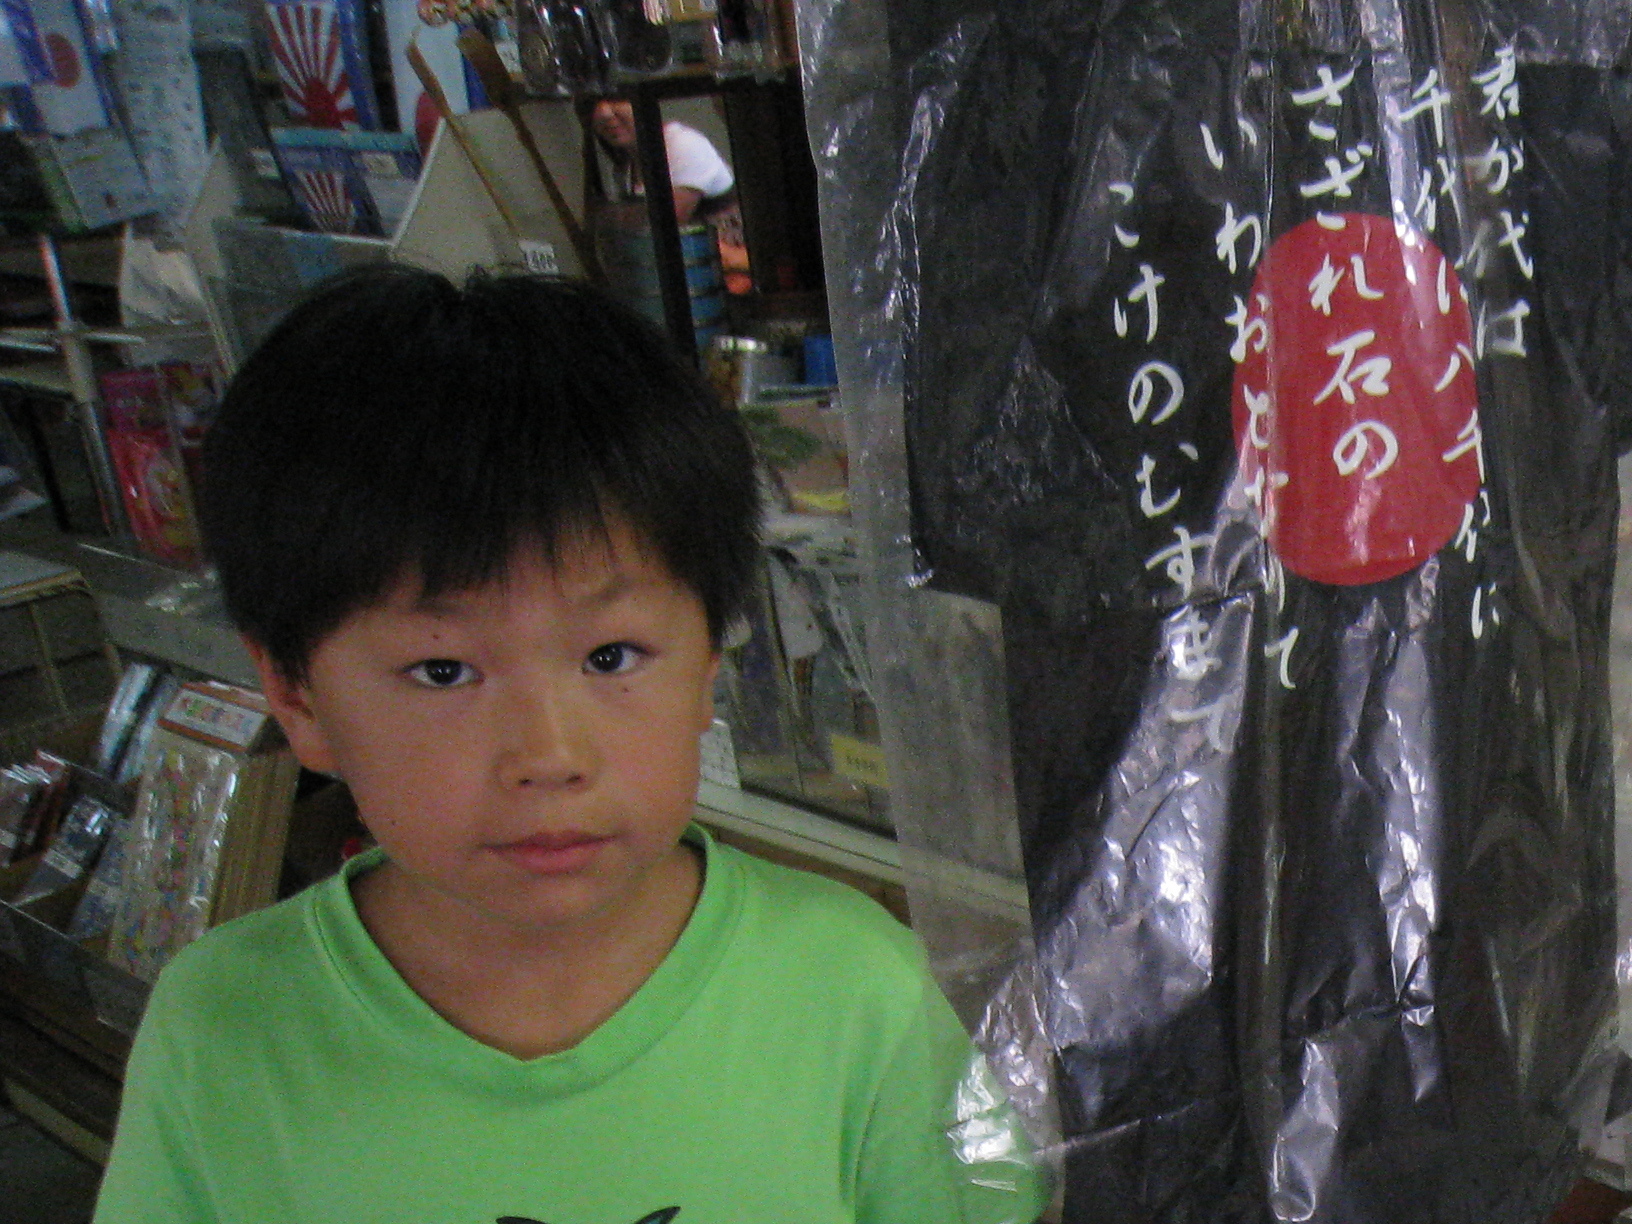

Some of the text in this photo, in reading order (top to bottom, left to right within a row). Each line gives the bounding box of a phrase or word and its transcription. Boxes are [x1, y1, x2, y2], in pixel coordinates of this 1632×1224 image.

[1291, 62, 1399, 480] さざれ石の
